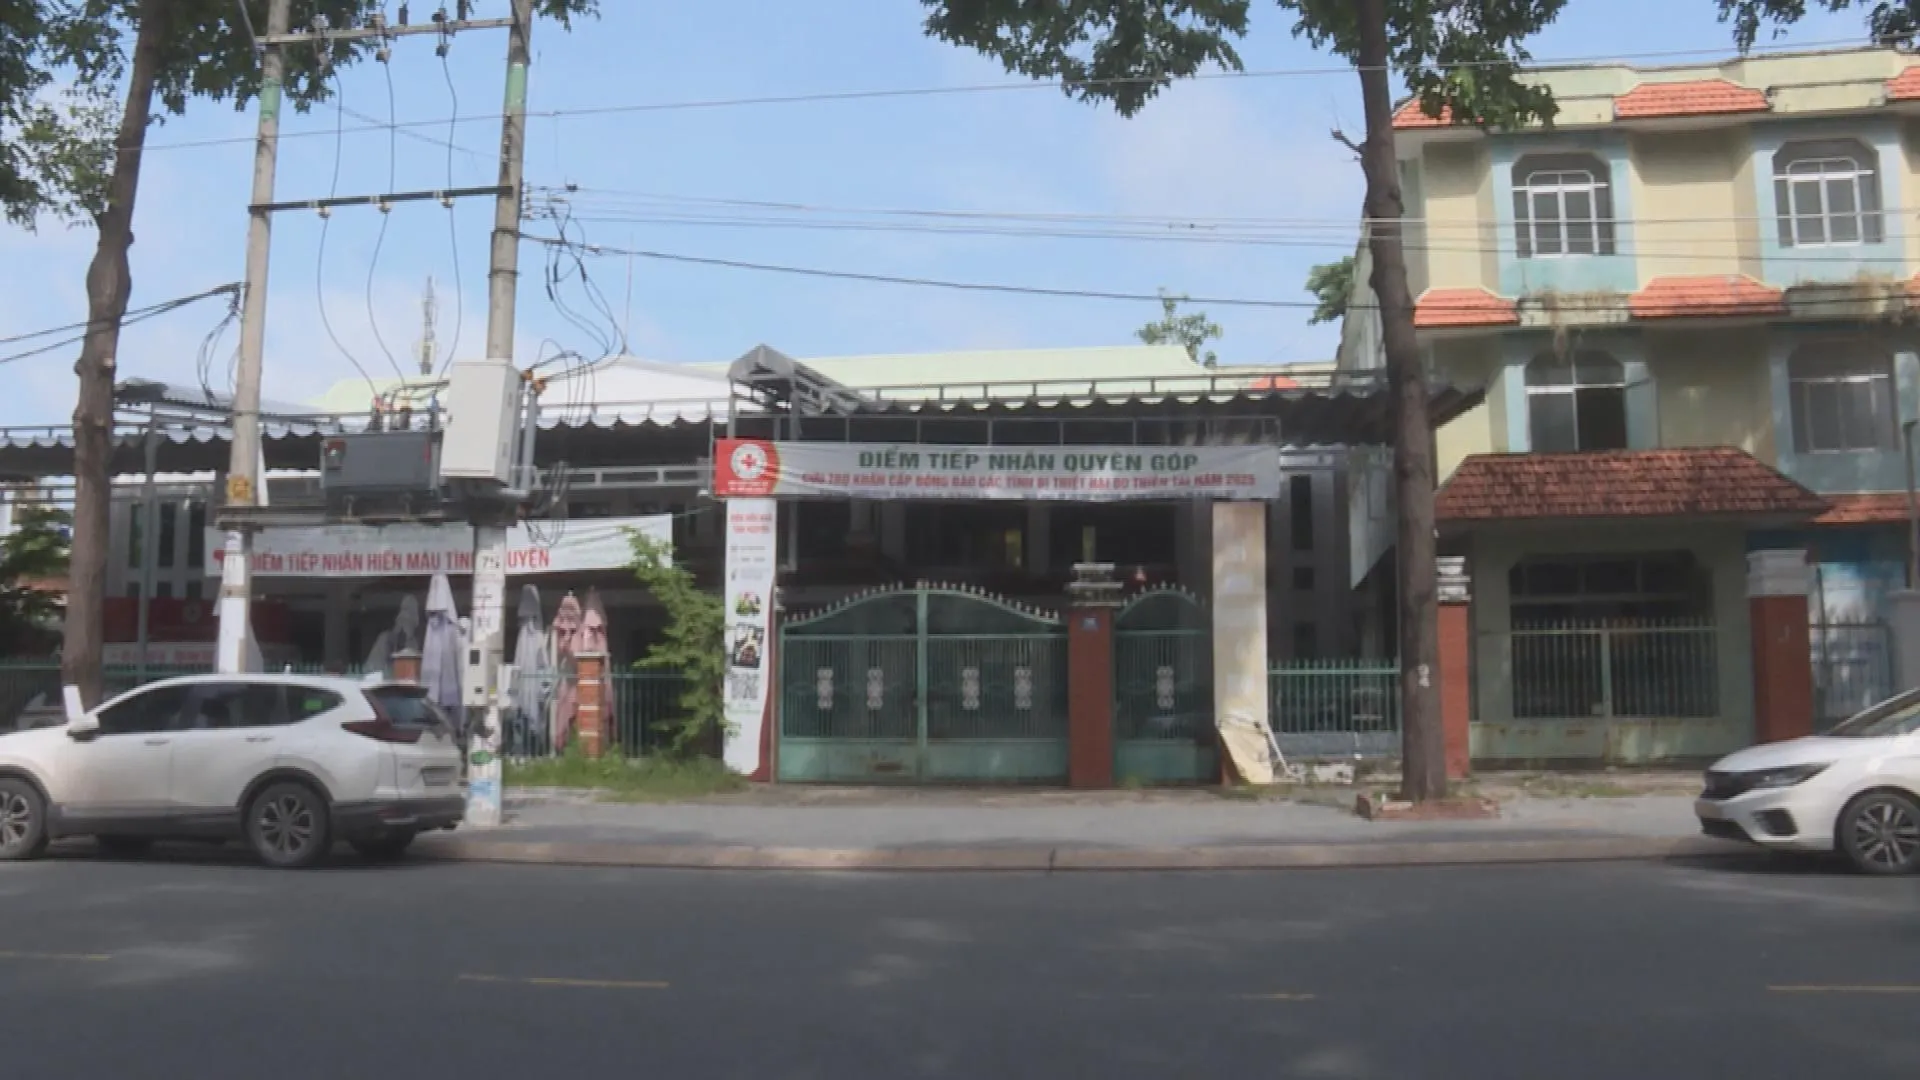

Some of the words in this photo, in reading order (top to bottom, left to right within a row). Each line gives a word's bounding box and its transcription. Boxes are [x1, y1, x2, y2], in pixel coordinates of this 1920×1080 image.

[858, 446, 920, 468] ĐIỂM
[927, 446, 980, 469] TIẾP
[988, 450, 1055, 473] NHẬN
[1063, 451, 1142, 472] QUYÊN
[1150, 451, 1199, 471] GÓP
[446, 546, 475, 570] TÌN
